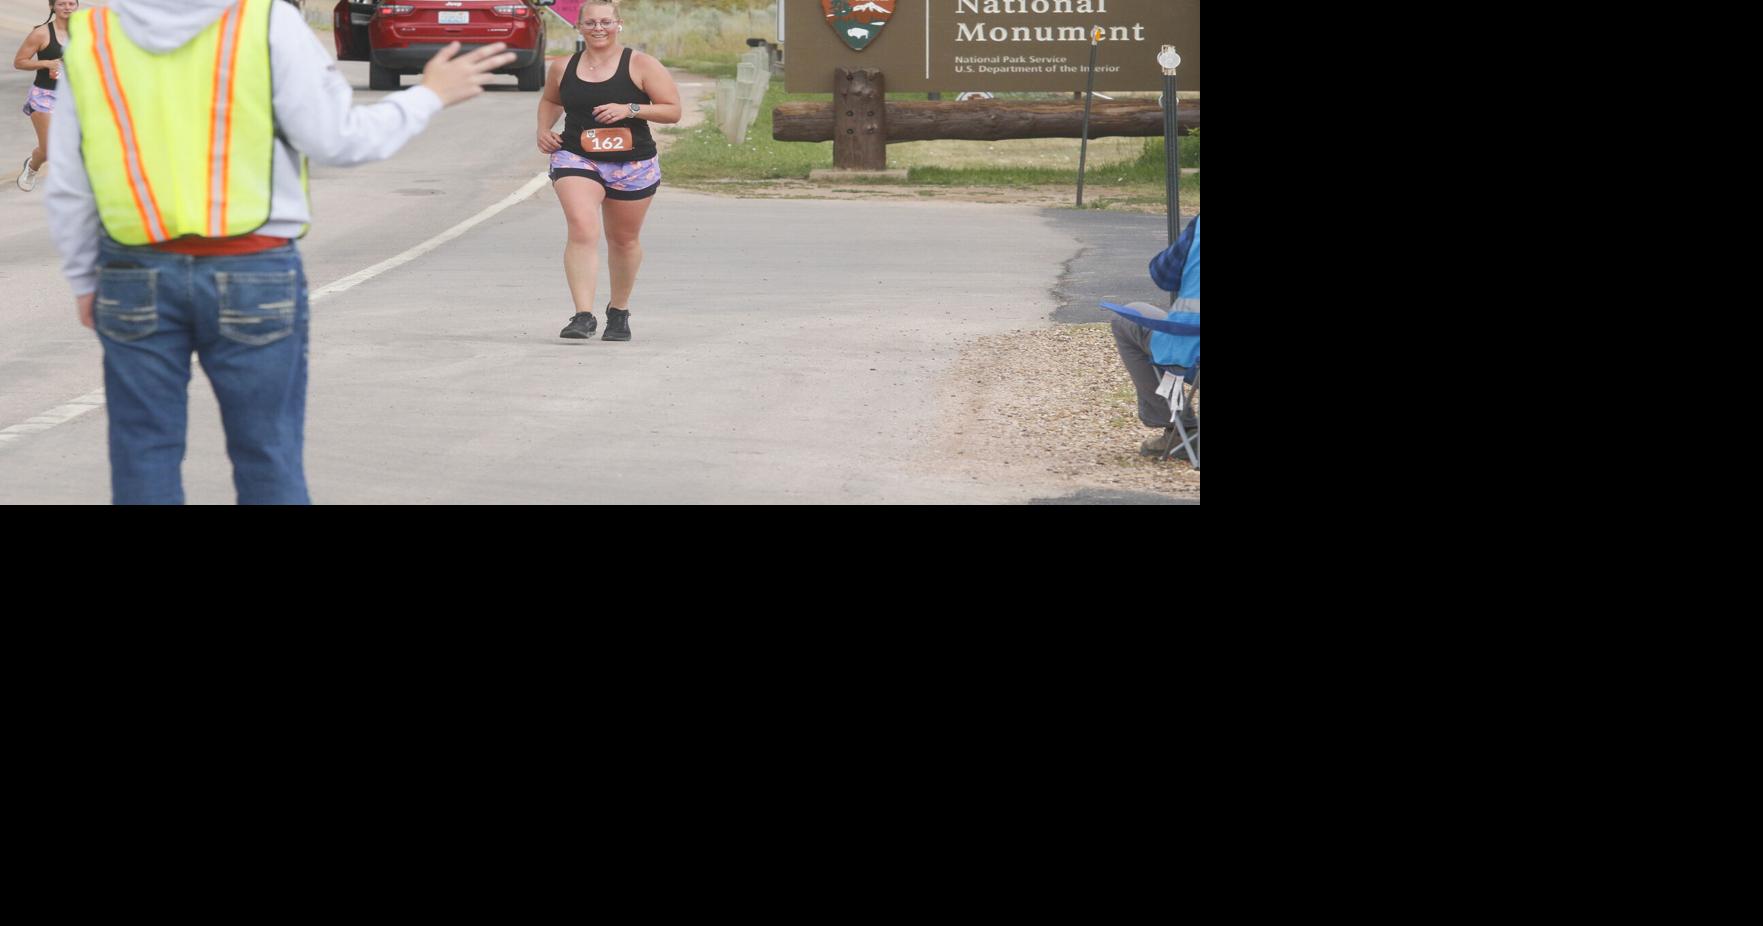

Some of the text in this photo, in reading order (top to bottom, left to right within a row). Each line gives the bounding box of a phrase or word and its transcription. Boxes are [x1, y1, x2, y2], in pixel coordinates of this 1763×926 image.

[955, 0, 1107, 14] National
[955, 22, 1145, 42] Monument
[955, 55, 1067, 63] National Park Service
[955, 65, 1120, 75] U.S. Department of the Inerior
[591, 136, 624, 150] 162
